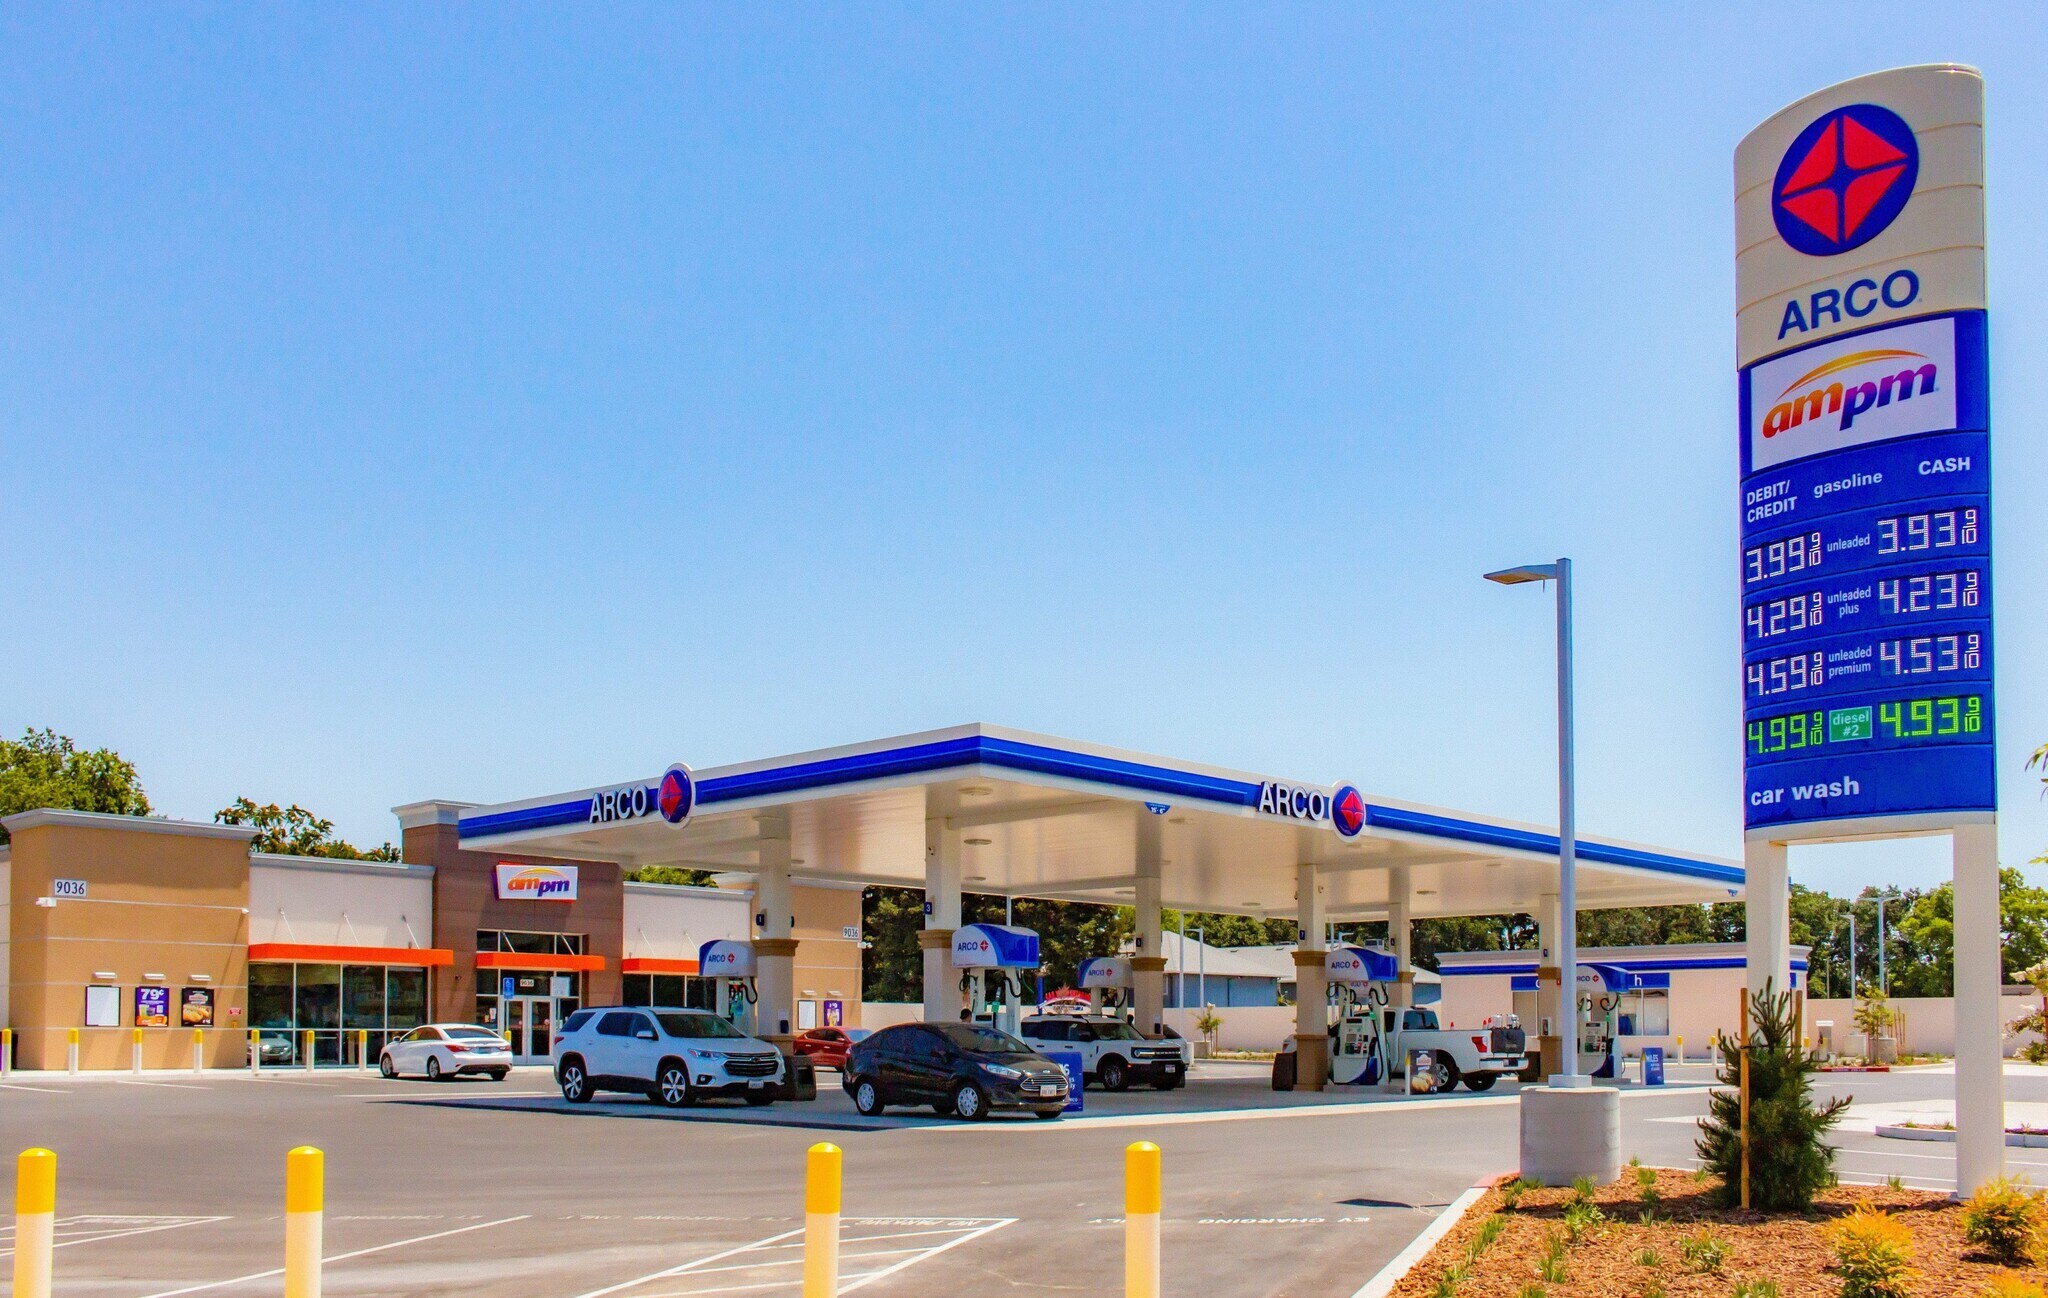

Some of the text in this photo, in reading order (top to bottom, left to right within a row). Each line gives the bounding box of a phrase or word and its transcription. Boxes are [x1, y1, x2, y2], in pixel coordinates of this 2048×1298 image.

[1777, 269, 1920, 340] ARCO
[1763, 362, 1937, 439] ampm
[1919, 457, 1971, 475] CASH
[1747, 480, 1790, 506] DEBIT/
[1814, 472, 1882, 498] gasoline
[1747, 496, 1797, 523] CREDIT
[1827, 534, 1870, 552] unleaded
[1878, 511, 1955, 554] 3.93
[1747, 536, 1805, 583] 3.99
[1828, 586, 1871, 604] unleaded
[1879, 574, 1957, 613] 4.23
[1747, 596, 1806, 638] 4.29
[1839, 602, 1859, 618] plus
[1828, 646, 1872, 663] unleaded
[1880, 636, 1958, 675] 4.53
[1748, 655, 1807, 696] 4.59
[1829, 662, 1871, 679] premium
[1833, 710, 1869, 725] diesel
[1880, 698, 1958, 737] 4.93
[1748, 714, 1806, 754] 4.99
[1843, 725, 1859, 737] #2
[589, 784, 648, 824] ARCO
[1257, 780, 1324, 820] ARCO
[1751, 776, 1860, 806] car wash
[56, 881, 85, 894] 9036
[508, 877, 570, 897] ampm
[926, 904, 931, 912] 3
[843, 927, 859, 938] 9036
[708, 954, 726, 962] ARCO
[958, 942, 978, 952] ARCO
